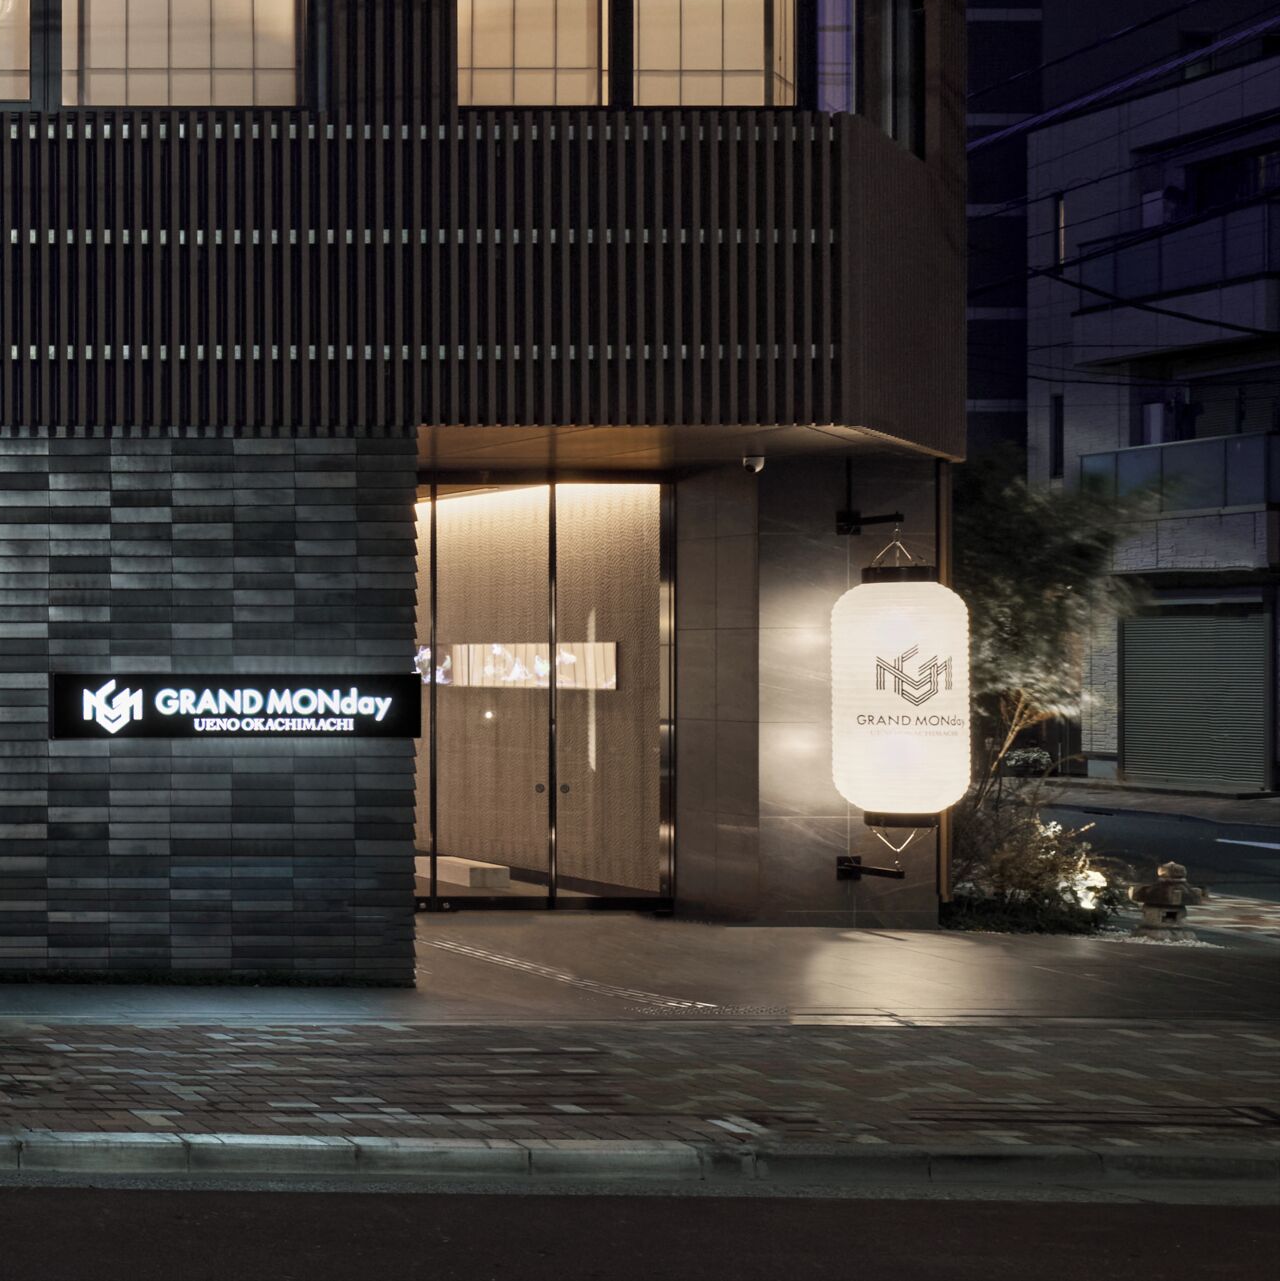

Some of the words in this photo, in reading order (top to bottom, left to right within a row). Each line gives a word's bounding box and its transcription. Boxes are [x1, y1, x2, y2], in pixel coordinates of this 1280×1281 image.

[154, 688, 264, 716] GRAND
[265, 686, 393, 722] MONday
[193, 717, 241, 732] UENO
[240, 717, 355, 732] OKACHIMACHI
[856, 714, 912, 726] GRAND
